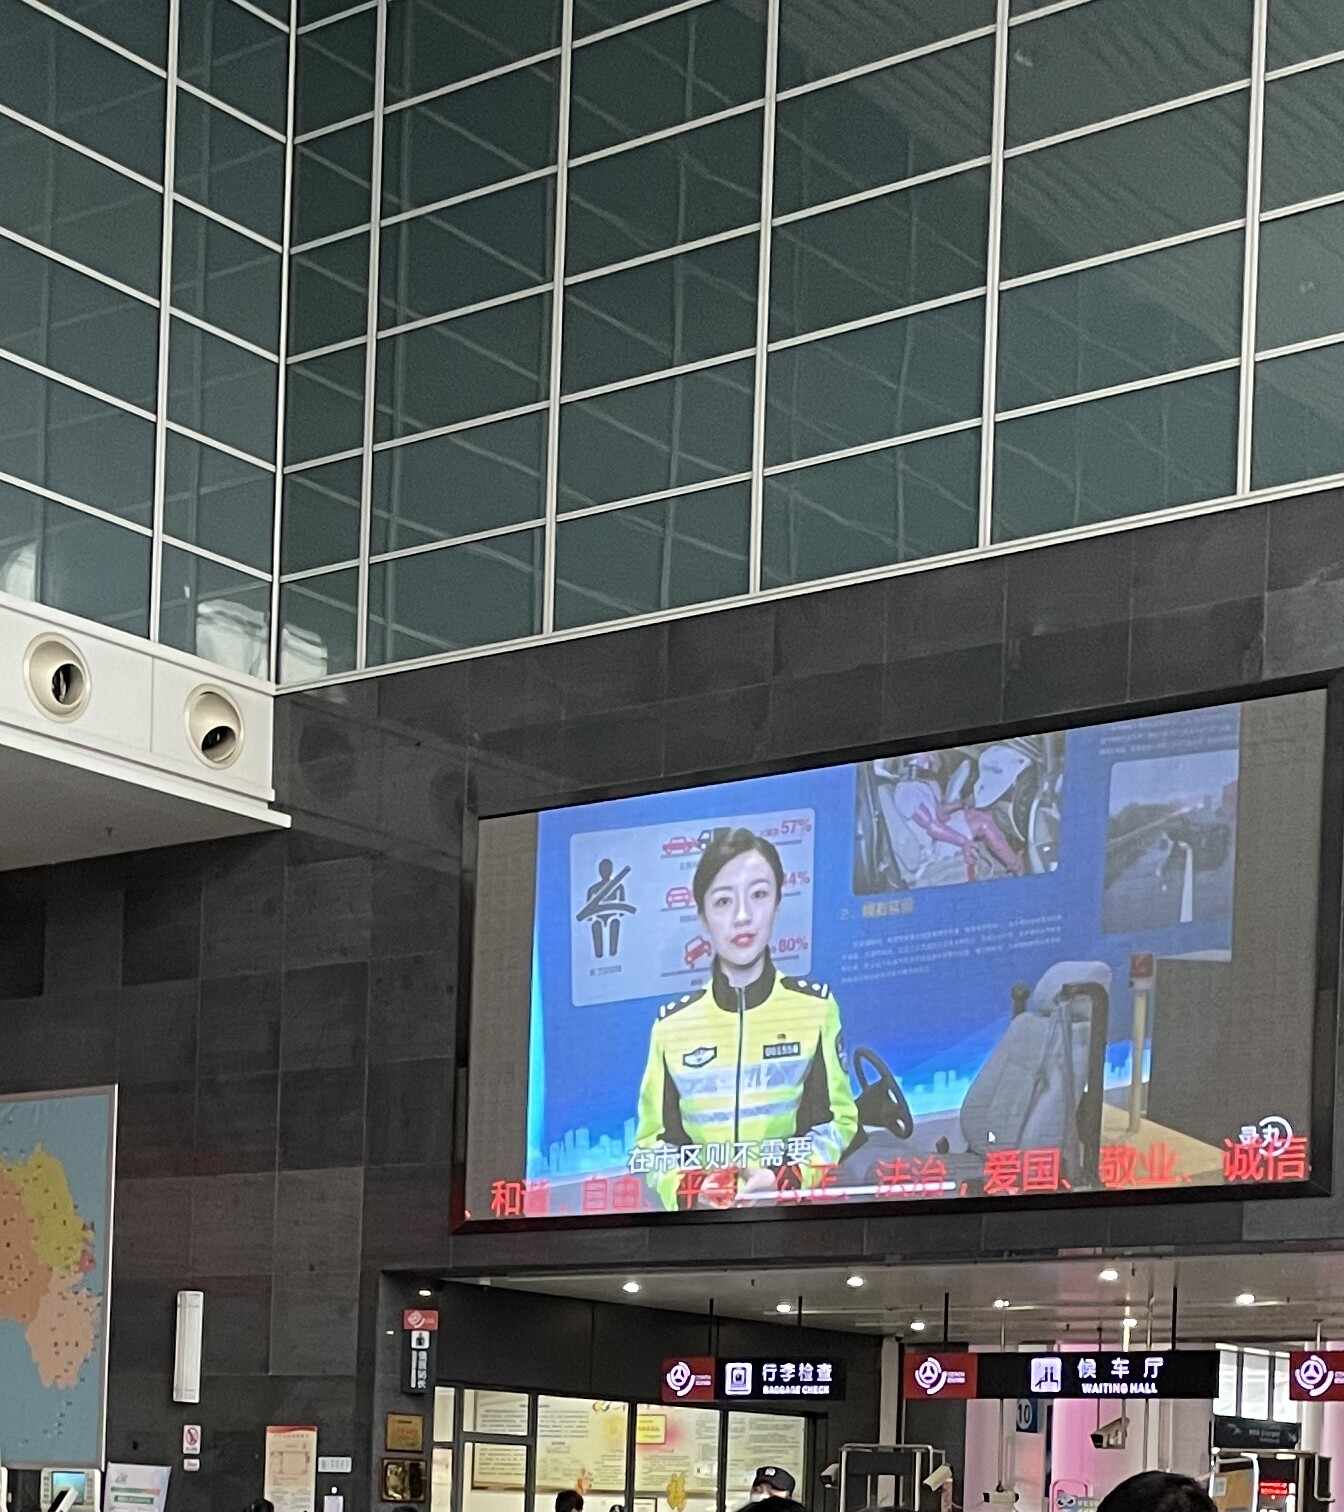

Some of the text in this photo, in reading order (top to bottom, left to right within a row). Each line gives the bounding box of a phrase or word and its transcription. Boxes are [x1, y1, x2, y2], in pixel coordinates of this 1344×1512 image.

[627, 1136, 814, 1175] 在市区则不需要
[762, 1362, 833, 1382] 行李检查
[1077, 1356, 1164, 1380] 候车厅
[1081, 1381, 1159, 1395] WAITING HALL
[1017, 1400, 1034, 1427] 10
